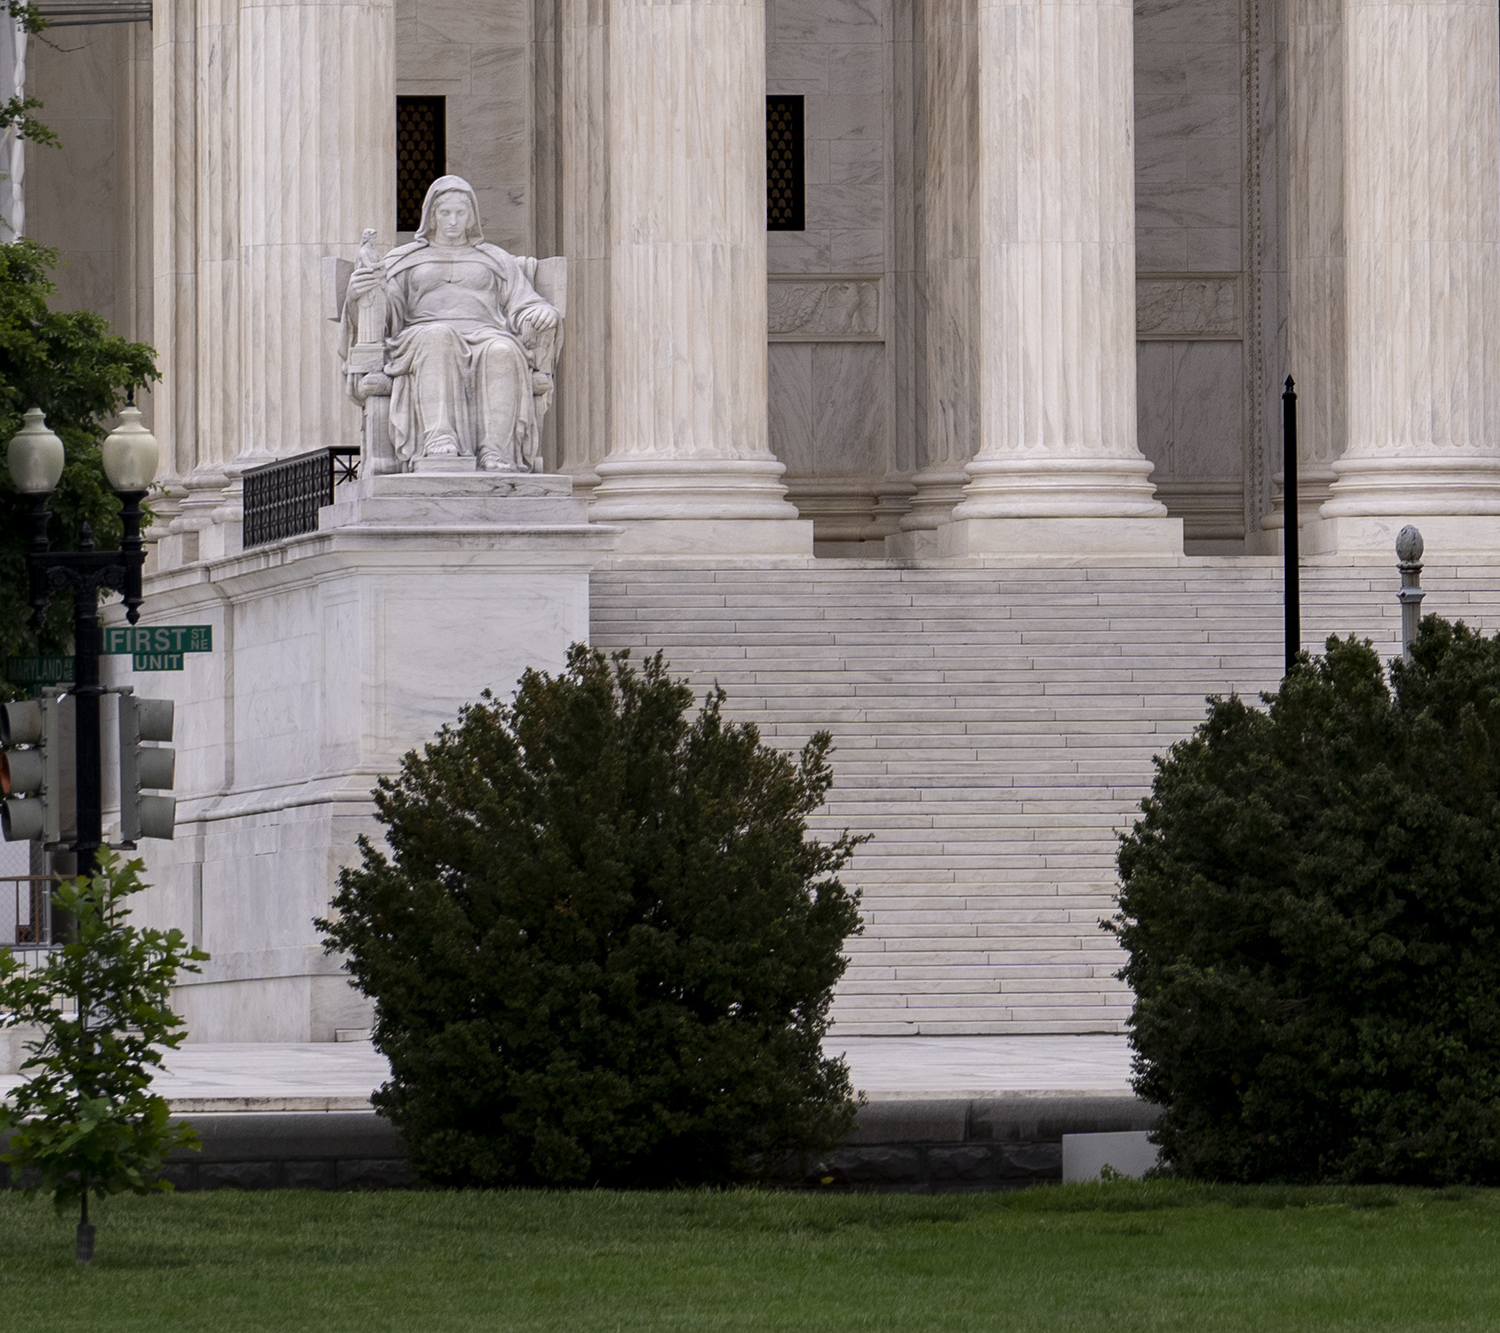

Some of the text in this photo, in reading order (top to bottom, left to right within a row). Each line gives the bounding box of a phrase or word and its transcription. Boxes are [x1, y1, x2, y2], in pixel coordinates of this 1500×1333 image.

[110, 628, 206, 652] FIRST ST
[190, 639, 208, 650] NE
[8, 658, 74, 681] MARYLAND AV
[135, 654, 180, 670] UNIT
